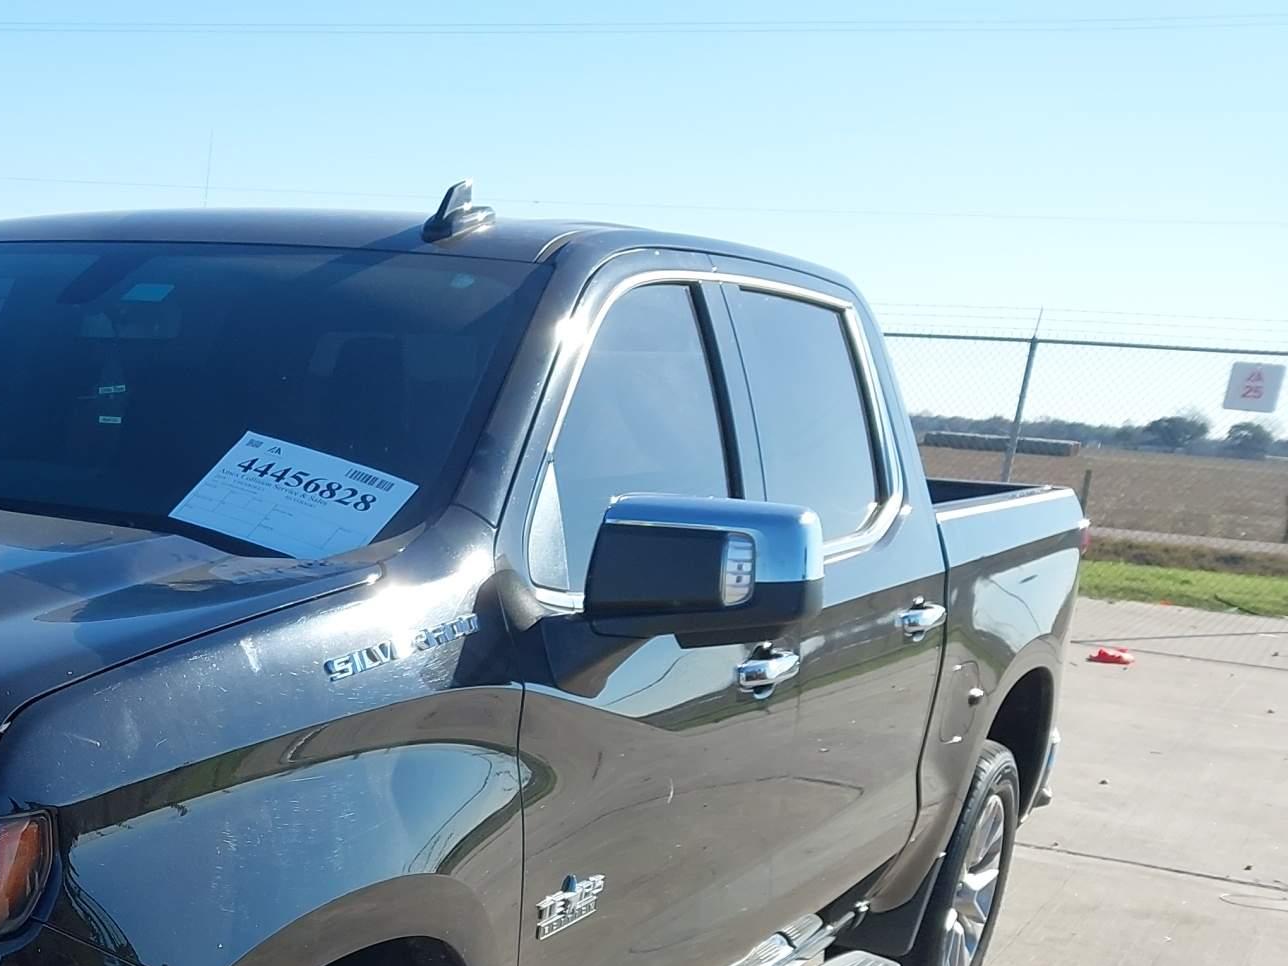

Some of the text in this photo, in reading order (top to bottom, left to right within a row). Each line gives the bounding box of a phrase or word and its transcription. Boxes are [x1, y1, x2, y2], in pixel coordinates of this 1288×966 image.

[1240, 384, 1265, 400] 25
[237, 457, 378, 513] 44456828
[323, 612, 482, 683] SILVRADO
